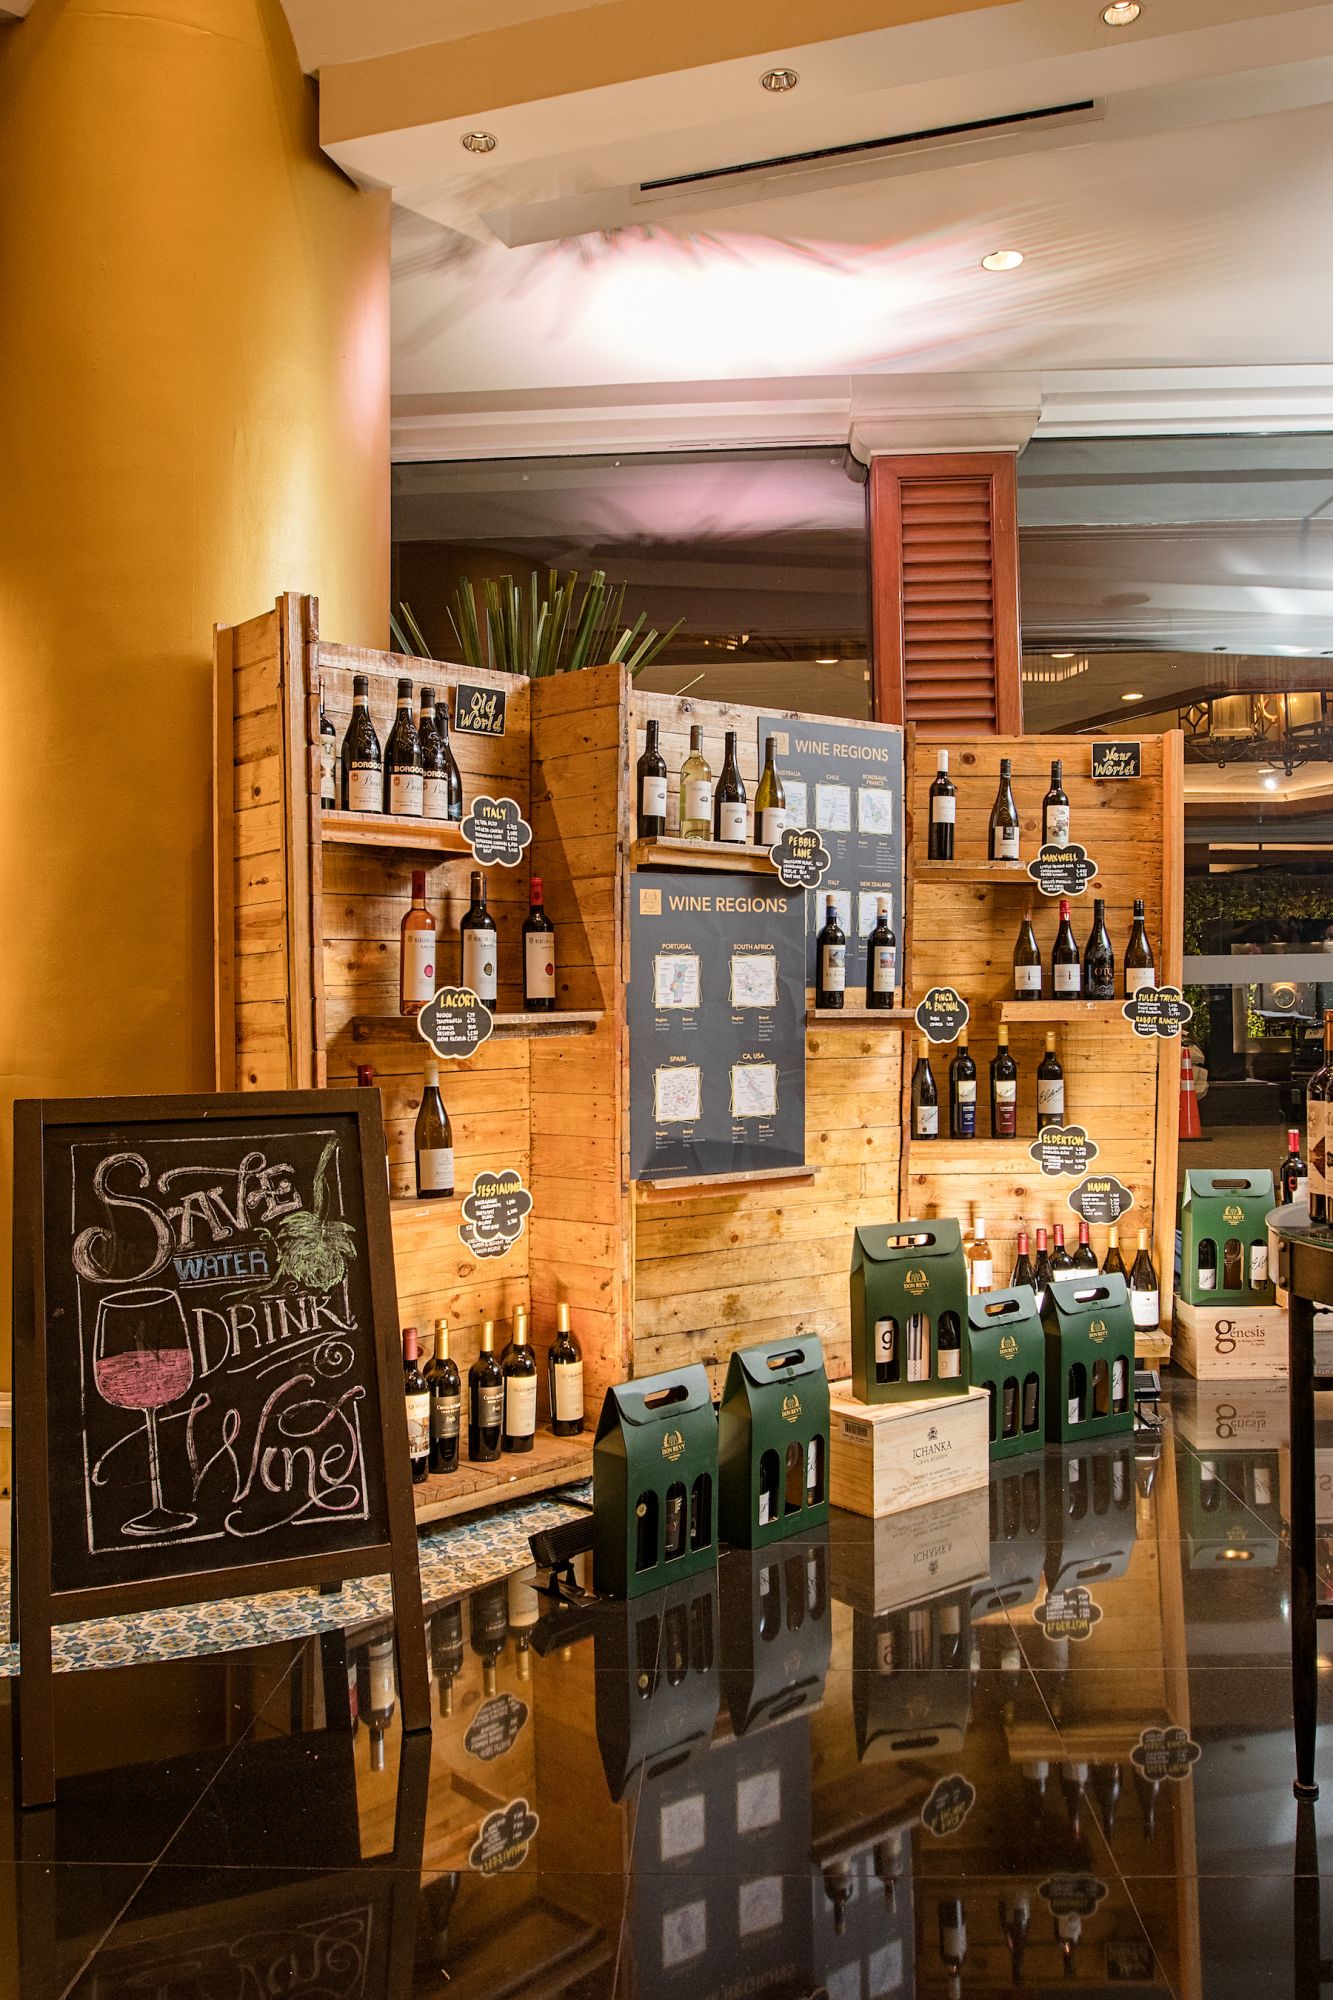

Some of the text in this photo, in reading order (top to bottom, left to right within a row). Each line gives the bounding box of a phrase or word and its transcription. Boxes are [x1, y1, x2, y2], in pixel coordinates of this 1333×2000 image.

[471, 692, 497, 714] Old
[460, 709, 503, 732] World
[795, 739, 889, 762] WINE REGIONS
[1103, 747, 1132, 762] New
[1094, 760, 1136, 776] World
[483, 806, 507, 820] ITALY
[789, 836, 817, 848] PEBBLE
[793, 848, 812, 858] LANE
[1042, 853, 1078, 862] MAXWELL
[668, 895, 788, 913] WINE REGIONS
[440, 993, 476, 1008] LACORT
[935, 993, 953, 1001] FINCA
[1043, 1134, 1084, 1146] ELDERTON
[1087, 1182, 1111, 1192] HAHN
[72, 1152, 303, 1283] SAVE
[174, 1250, 269, 1281] WATER
[192, 1294, 358, 1378] DRINK
[1215, 1319, 1265, 1354] génesis
[92, 1374, 366, 1515] Wine
[662, 1446, 672, 1455] DON
[912, 1440, 952, 1459] ICHANKA
